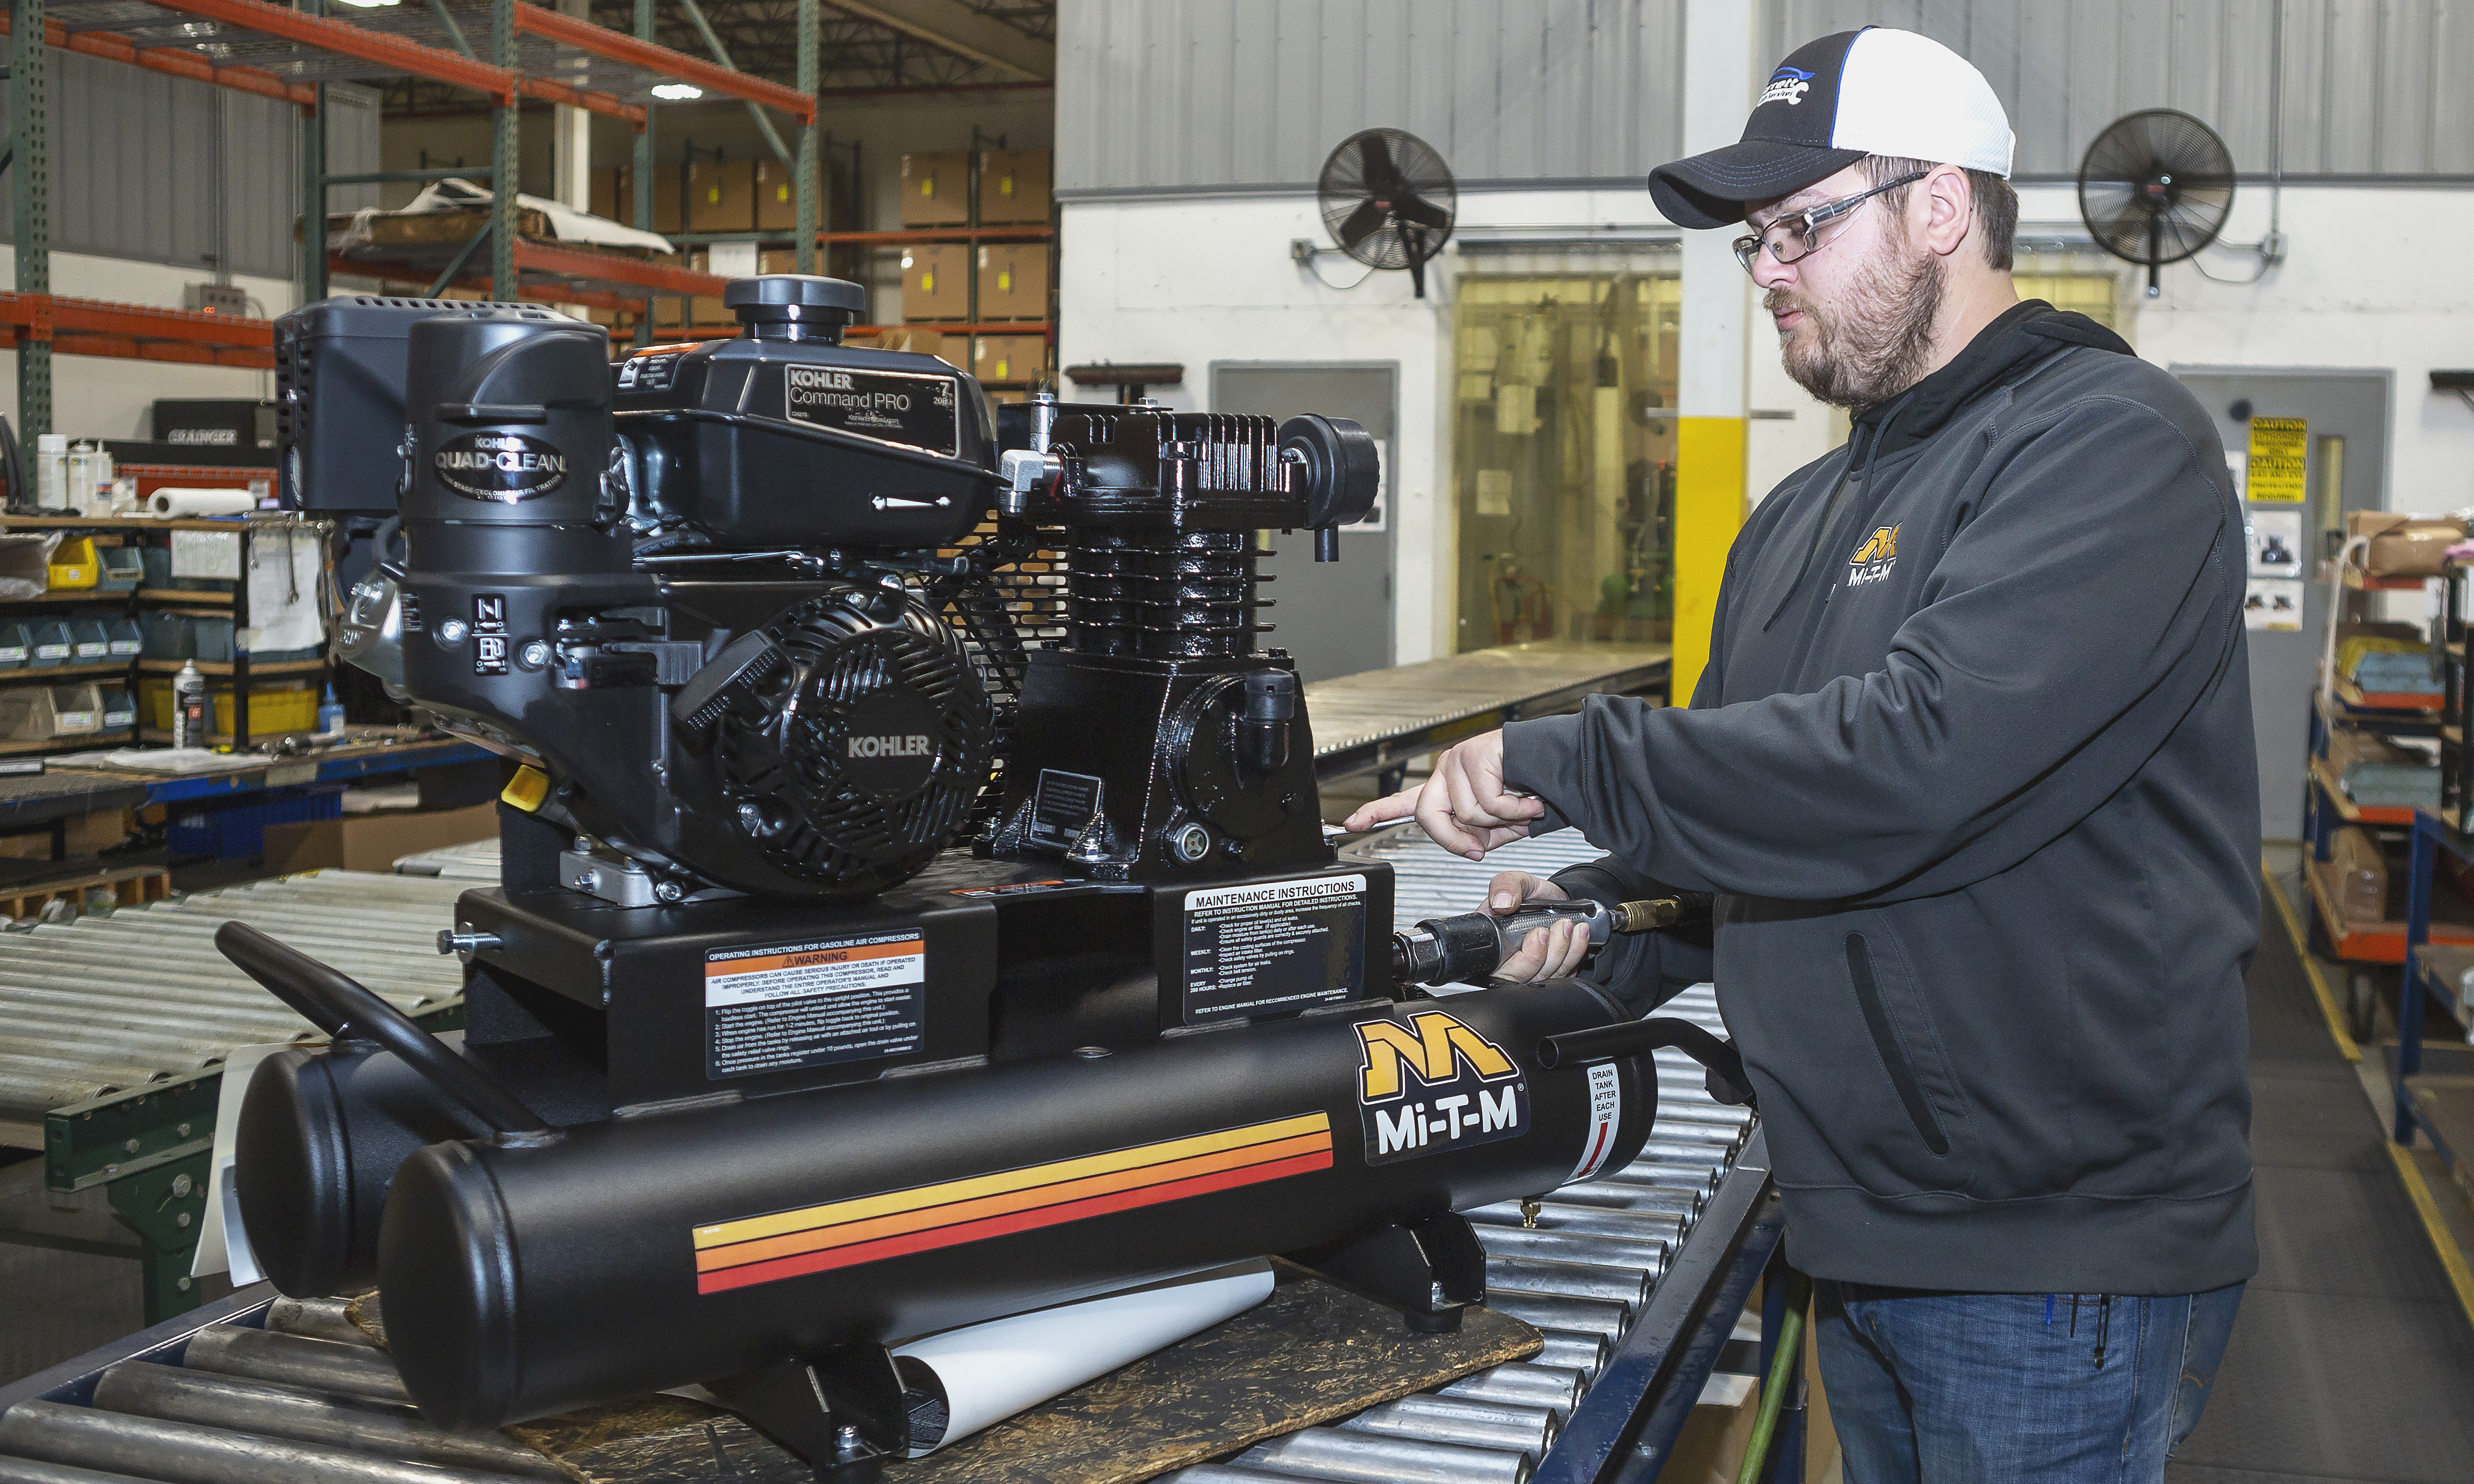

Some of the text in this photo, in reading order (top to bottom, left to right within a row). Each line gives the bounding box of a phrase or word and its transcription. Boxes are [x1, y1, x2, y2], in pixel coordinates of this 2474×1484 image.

[791, 370, 852, 389] KOHLER
[940, 382, 950, 397] 7
[790, 387, 910, 410] Command PRO
[2254, 420, 2305, 430] CAUTION
[435, 451, 563, 471] QUAD-CLEAN
[2252, 458, 2304, 469] CAUTION
[1847, 562, 1893, 586] Mi-T-M
[849, 735, 930, 758] KOHLER
[1196, 881, 1354, 907] MAINTENANCE INSTRUCTIONS
[1222, 905, 1257, 914] INSTRUCTION
[1320, 894, 1357, 903] INSTRUCTIONS.
[709, 950, 750, 960] OPERATING
[752, 945, 802, 956] INSTRUCTIONS
[820, 940, 854, 949] GASOLINE
[868, 933, 918, 944] COMPRESSORS
[794, 951, 847, 966] WARNING
[723, 973, 768, 982] COMPRESSORS
[741, 985, 779, 994] UNDERSTAND
[825, 981, 866, 990] PRECAUTIONS.
[1266, 995, 1299, 1004] RECOMMENDED
[1317, 987, 1348, 996] MAINTENANCE.
[826, 1008, 861, 1017] accompanying
[1592, 1069, 1613, 1080] DRAIN
[1595, 1080, 1613, 1090] TANK
[1595, 1090, 1616, 1101] AFTER
[1596, 1101, 1615, 1112] EACH
[1376, 1086, 1517, 1154] Mi-T-M
[1599, 1112, 1612, 1121] USE
